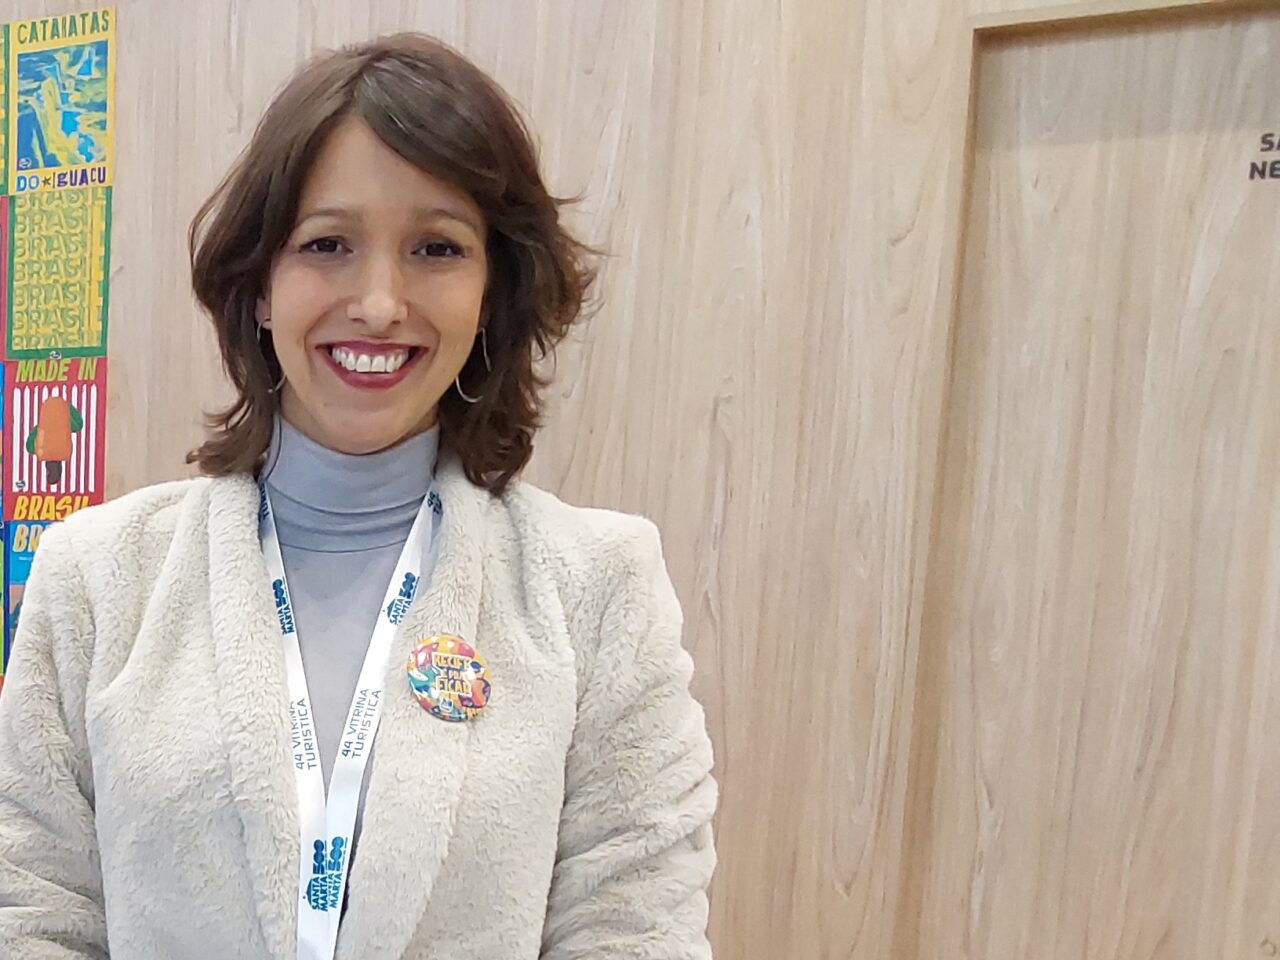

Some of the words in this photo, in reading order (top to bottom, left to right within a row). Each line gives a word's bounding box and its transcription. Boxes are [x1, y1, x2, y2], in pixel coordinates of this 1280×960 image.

[16, 175, 40, 192] DO
[15, 359, 72, 383] MADE
[78, 357, 98, 381] IN
[347, 688, 369, 736] VITRINA
[351, 690, 381, 759] TURISTICA
[297, 698, 317, 770] TURISTICA
[341, 741, 354, 757] 44
